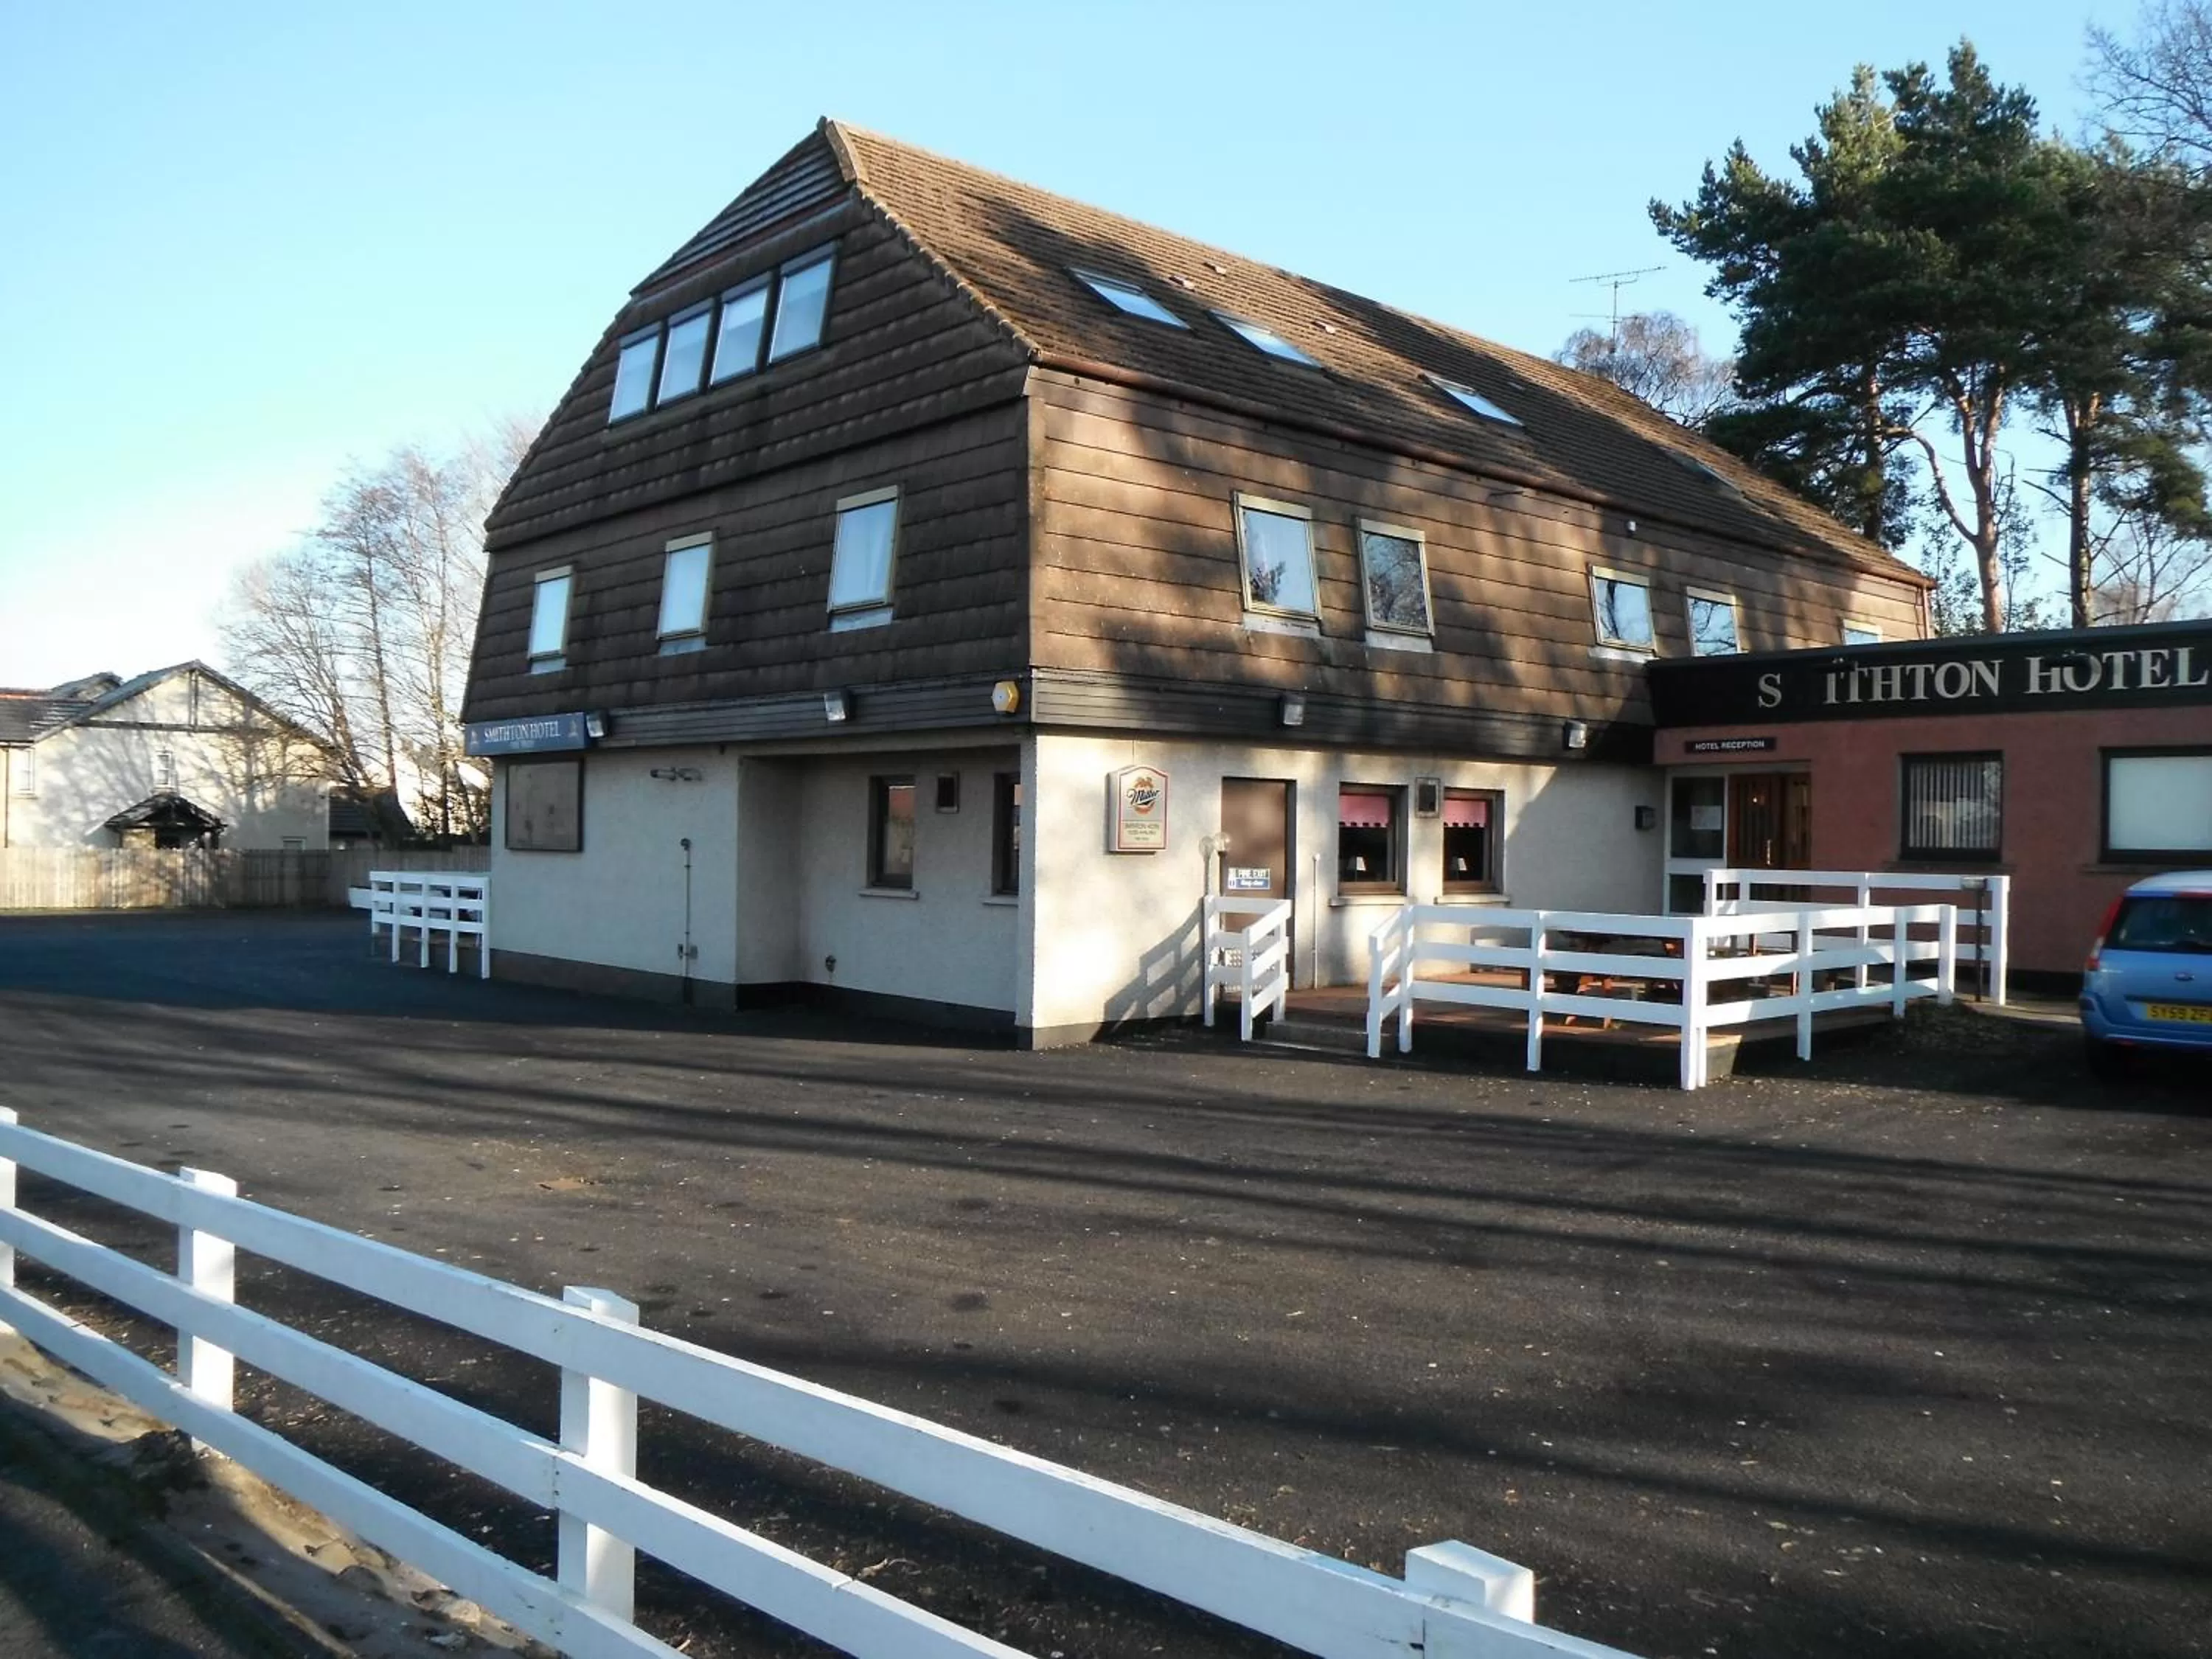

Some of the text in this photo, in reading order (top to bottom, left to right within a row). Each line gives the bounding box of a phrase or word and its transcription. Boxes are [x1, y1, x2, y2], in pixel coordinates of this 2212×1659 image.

[1758, 647, 2210, 708] SITHTON HOTEL
[484, 720, 560, 742] SMITHTON HOTEL
[1721, 740, 1764, 748] RECEPTION
[1127, 788, 1161, 805] Miller
